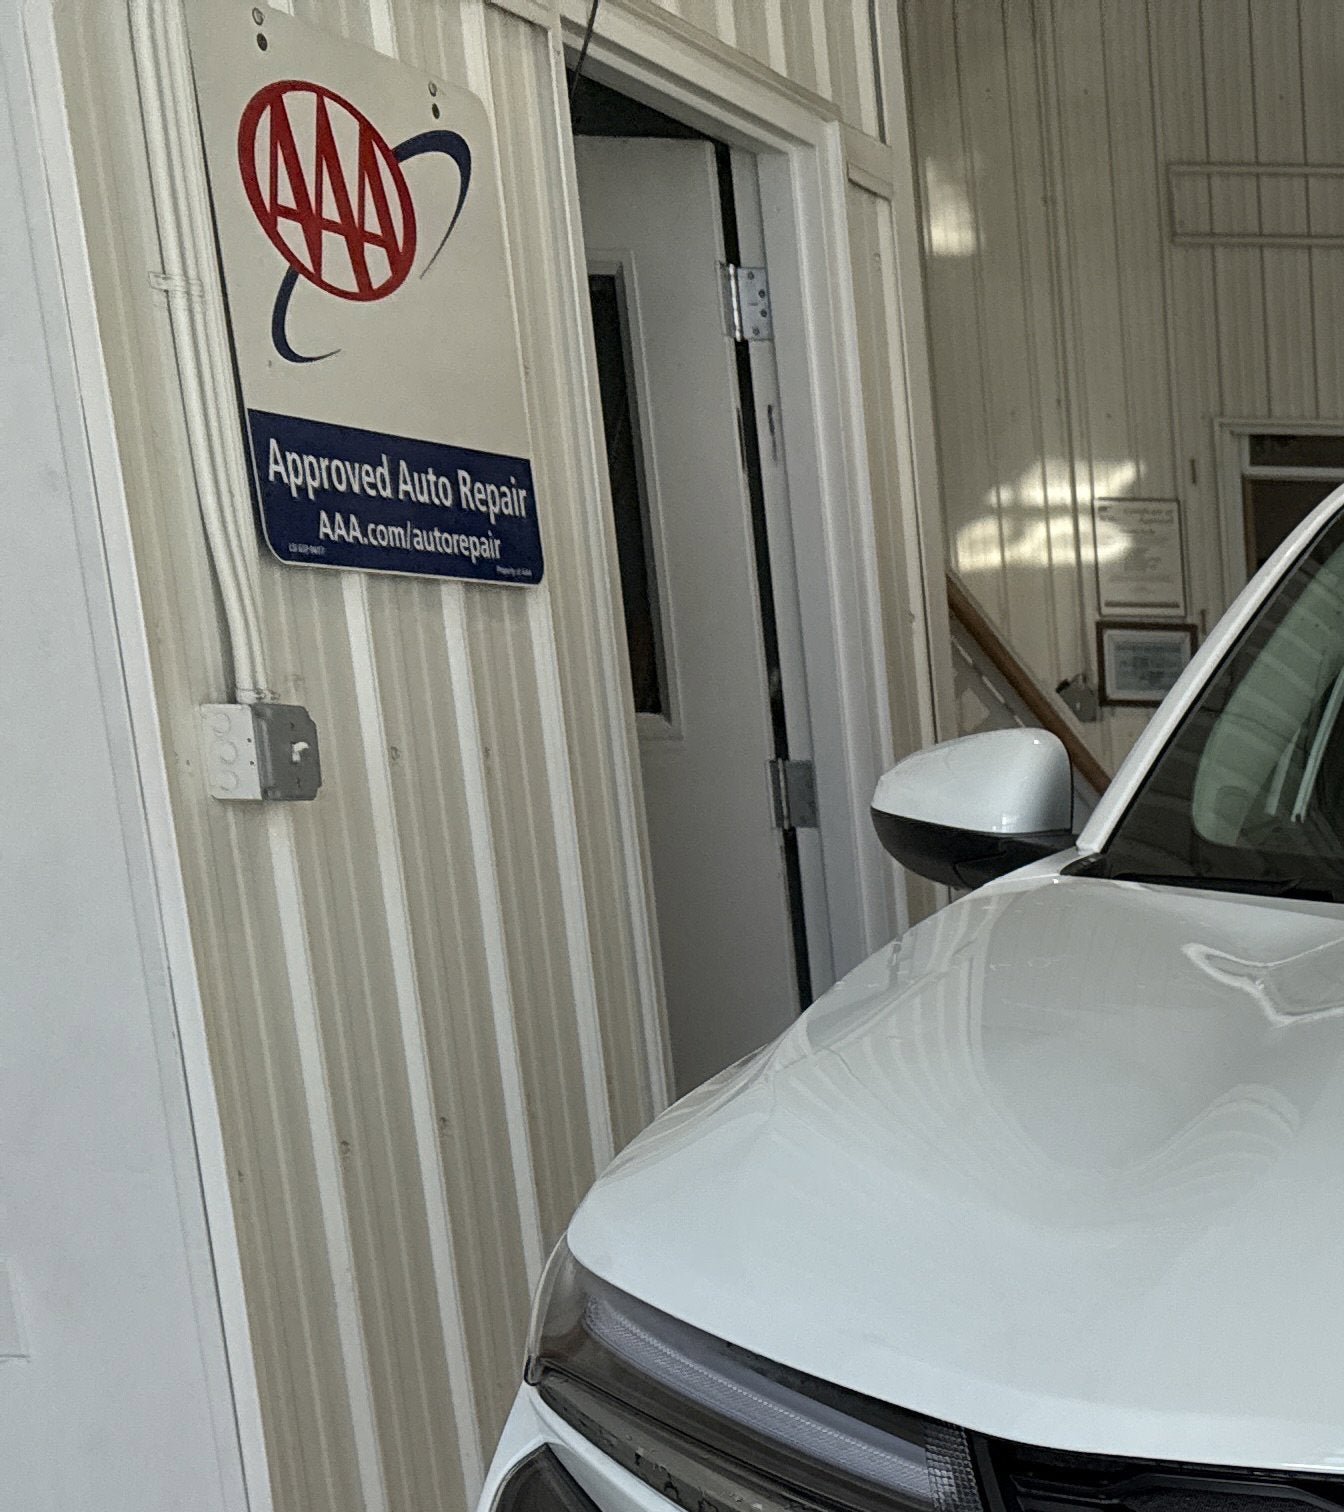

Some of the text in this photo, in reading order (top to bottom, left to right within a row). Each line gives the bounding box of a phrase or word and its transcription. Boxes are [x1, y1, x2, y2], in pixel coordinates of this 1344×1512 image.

[262, 86, 406, 299] AAA
[268, 437, 528, 522] Approved Auto Repair
[319, 509, 501, 562] AAA.com/autorepair
